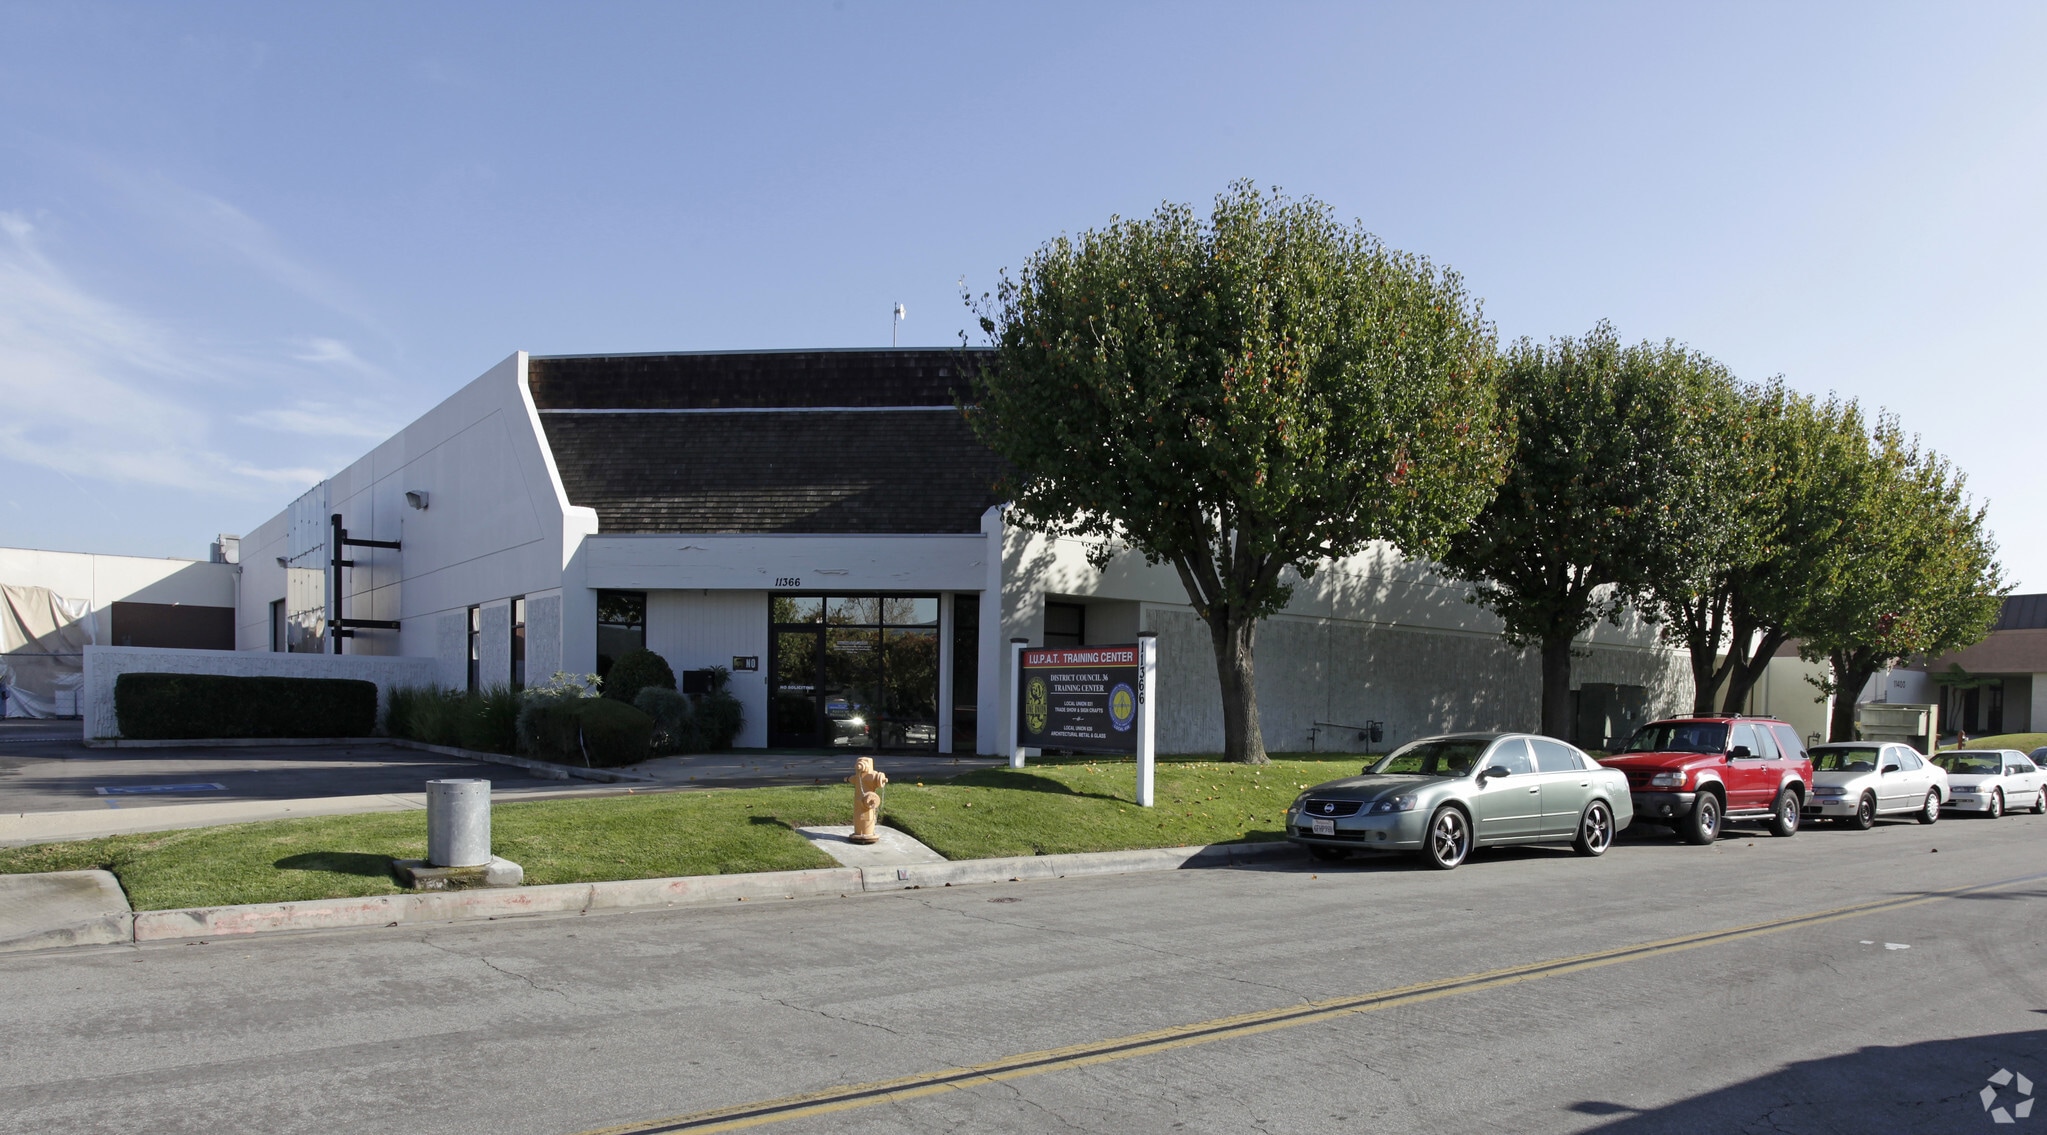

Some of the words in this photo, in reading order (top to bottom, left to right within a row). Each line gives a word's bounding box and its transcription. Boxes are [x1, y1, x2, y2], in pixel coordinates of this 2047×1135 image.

[775, 577, 801, 587] 11366
[1029, 653, 1060, 664] I.U.P.A.T.
[1063, 652, 1099, 663] TRAINING
[1100, 651, 1133, 662] CENTER
[745, 658, 756, 668] NO
[1075, 674, 1101, 682] COUNCIL
[1101, 673, 1109, 682] 36
[1054, 684, 1081, 692] TRAINING
[1081, 684, 1104, 692] CENTER
[1893, 680, 1906, 688] 11400
